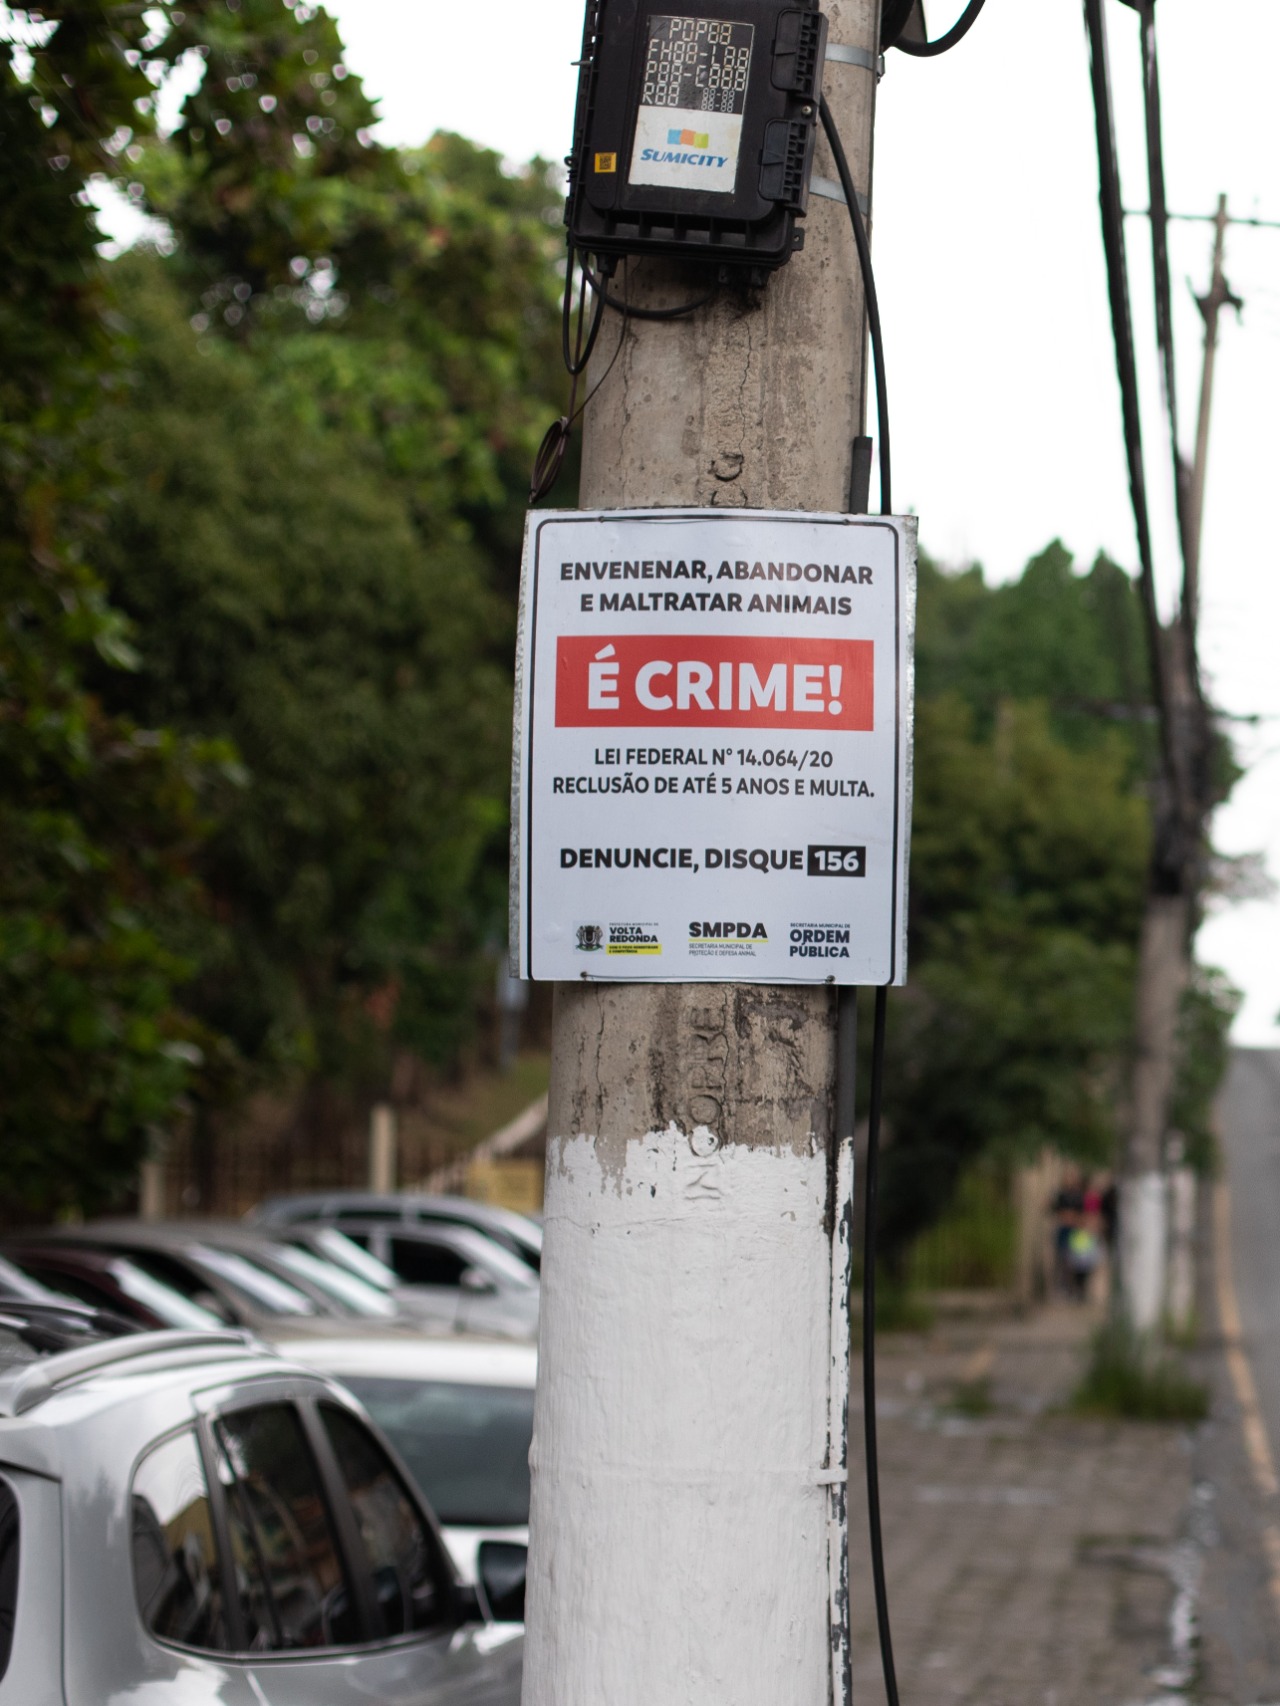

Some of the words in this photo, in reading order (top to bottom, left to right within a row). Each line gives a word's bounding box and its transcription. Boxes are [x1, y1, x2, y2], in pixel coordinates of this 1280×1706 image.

[640, 148, 729, 168] SUMICITY
[560, 561, 713, 584] ENVENENAR,
[717, 561, 873, 585] ABANDONAR
[580, 594, 593, 612] E
[600, 593, 743, 612] MALTRATAR
[747, 595, 852, 616] ANIMAIS
[588, 644, 620, 710] É
[635, 660, 843, 716] CRIME!
[594, 748, 620, 765] LEI
[626, 748, 707, 766] FEDERAL
[737, 750, 833, 771] 14.064/20
[553, 773, 649, 794] RECLUSÃO
[655, 777, 679, 794] DE
[682, 773, 717, 794] ATÉ
[721, 778, 732, 795] 5
[736, 778, 789, 796] ANOS
[795, 779, 805, 796] E
[810, 780, 874, 798] MULTA.
[560, 848, 700, 874] DENUNCIE,
[705, 849, 803, 874] DISQUE
[814, 850, 860, 872] 156
[609, 927, 642, 935] VOLTA
[609, 935, 658, 943] REDONDA
[688, 922, 768, 938] SMPDA
[790, 929, 850, 943] ORDEM
[790, 942, 850, 957] PÚBLICA
